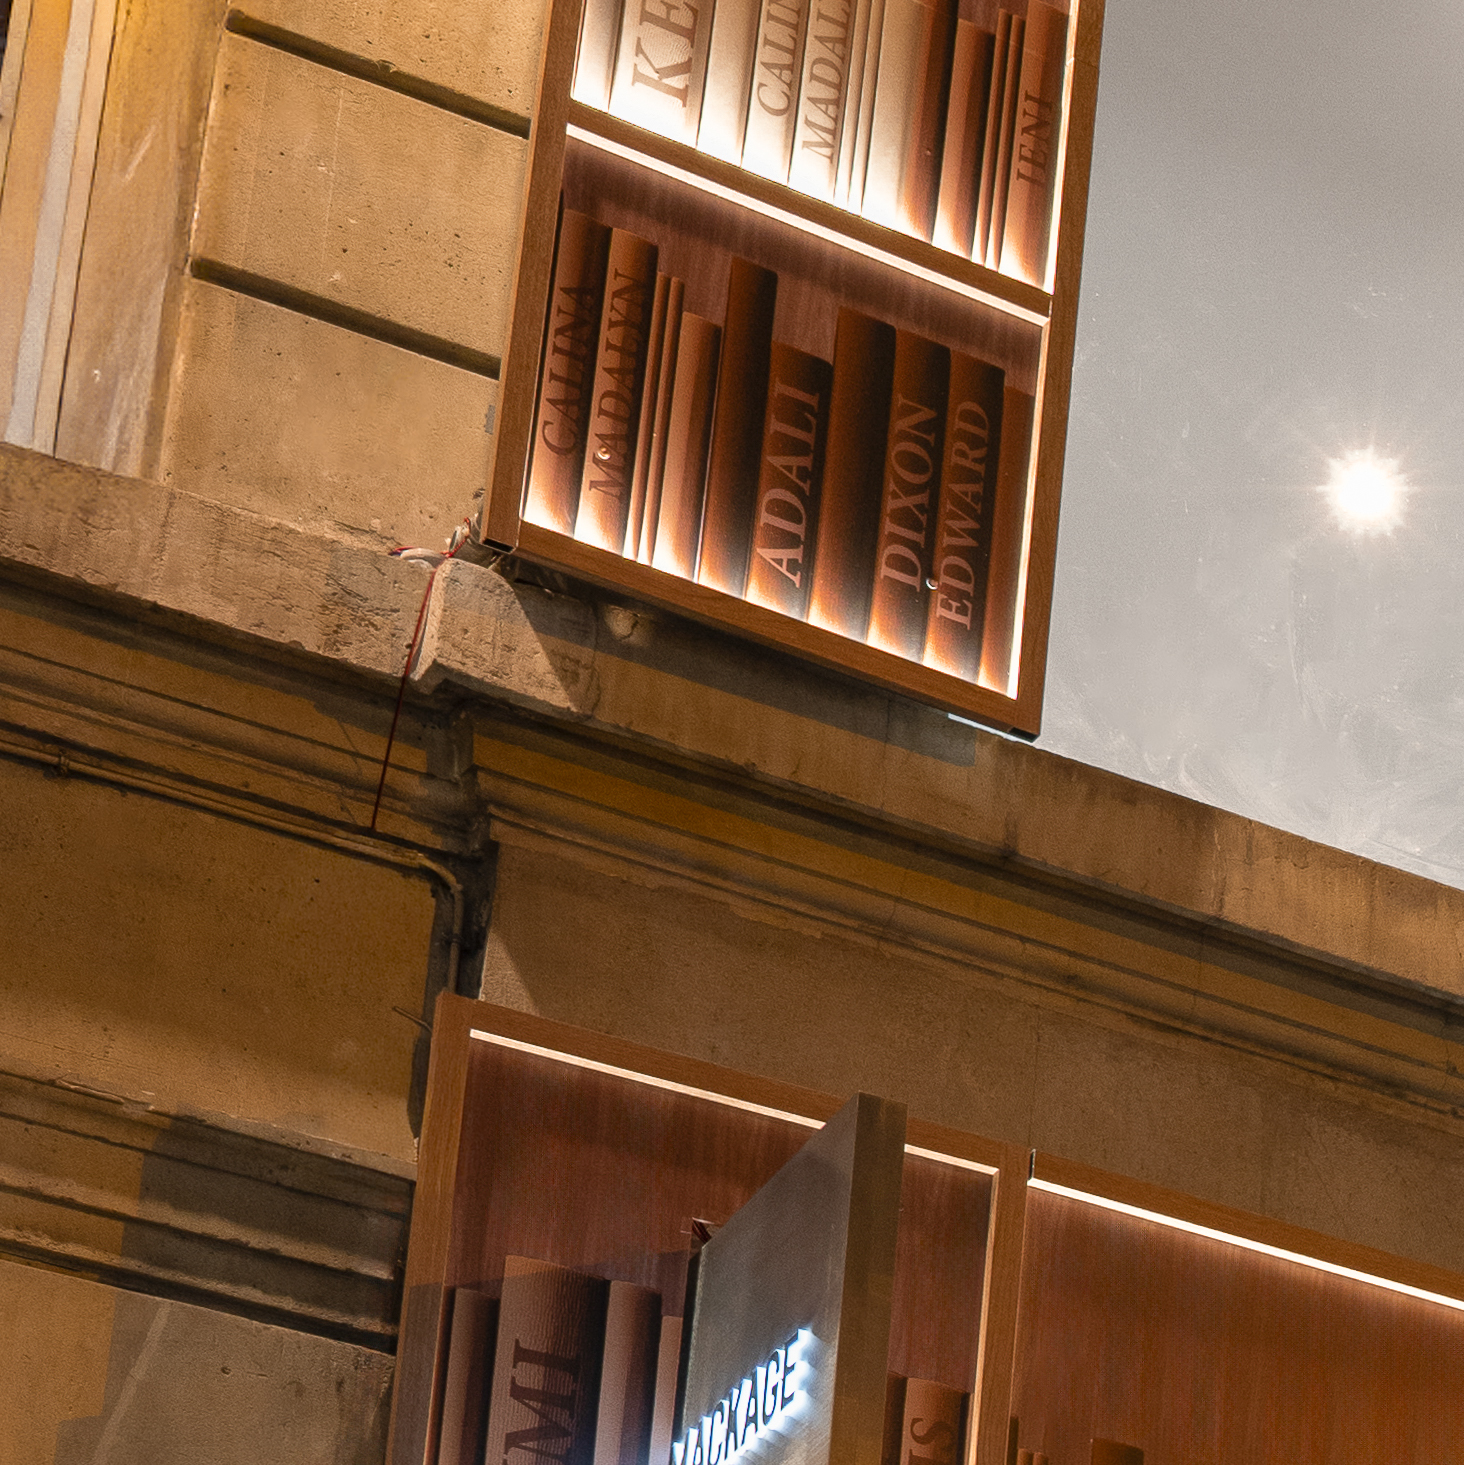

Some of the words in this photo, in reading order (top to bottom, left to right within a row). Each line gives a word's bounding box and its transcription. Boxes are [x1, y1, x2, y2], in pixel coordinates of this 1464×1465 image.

[542, 283, 594, 458] CALINA
[588, 268, 645, 505] MADALYN
[756, 378, 821, 588] ADALI
[880, 394, 938, 593] DIXON
[935, 401, 991, 630] EDWARD
